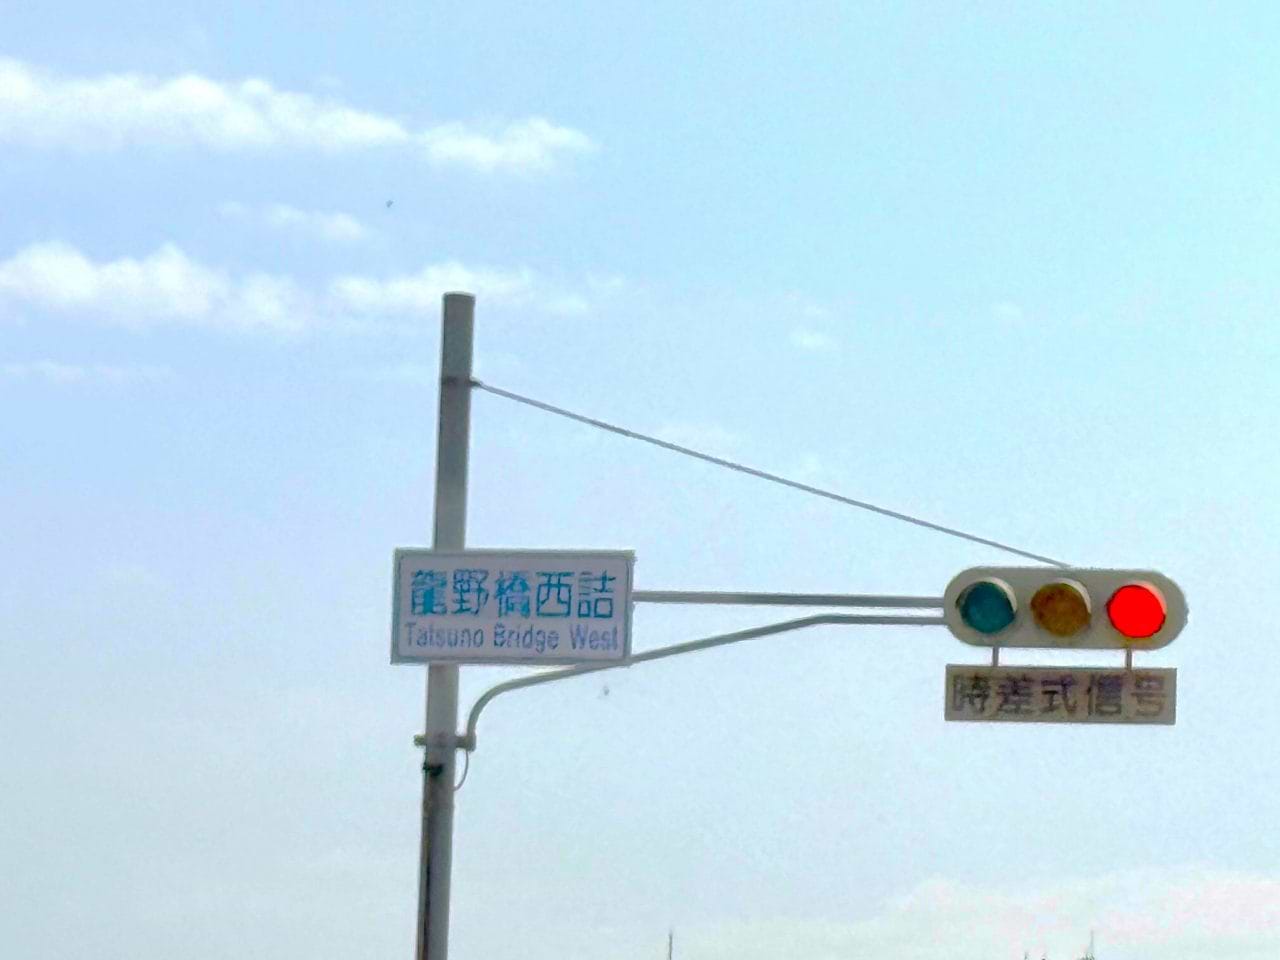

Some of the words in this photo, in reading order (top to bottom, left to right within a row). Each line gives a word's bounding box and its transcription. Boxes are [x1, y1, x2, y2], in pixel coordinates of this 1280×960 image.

[410, 569, 617, 618] 龍野橋西詰
[404, 622, 484, 648] Tatsuno
[493, 624, 560, 653] Bridge
[570, 624, 619, 650] West
[953, 673, 1167, 717] 時差式信号
